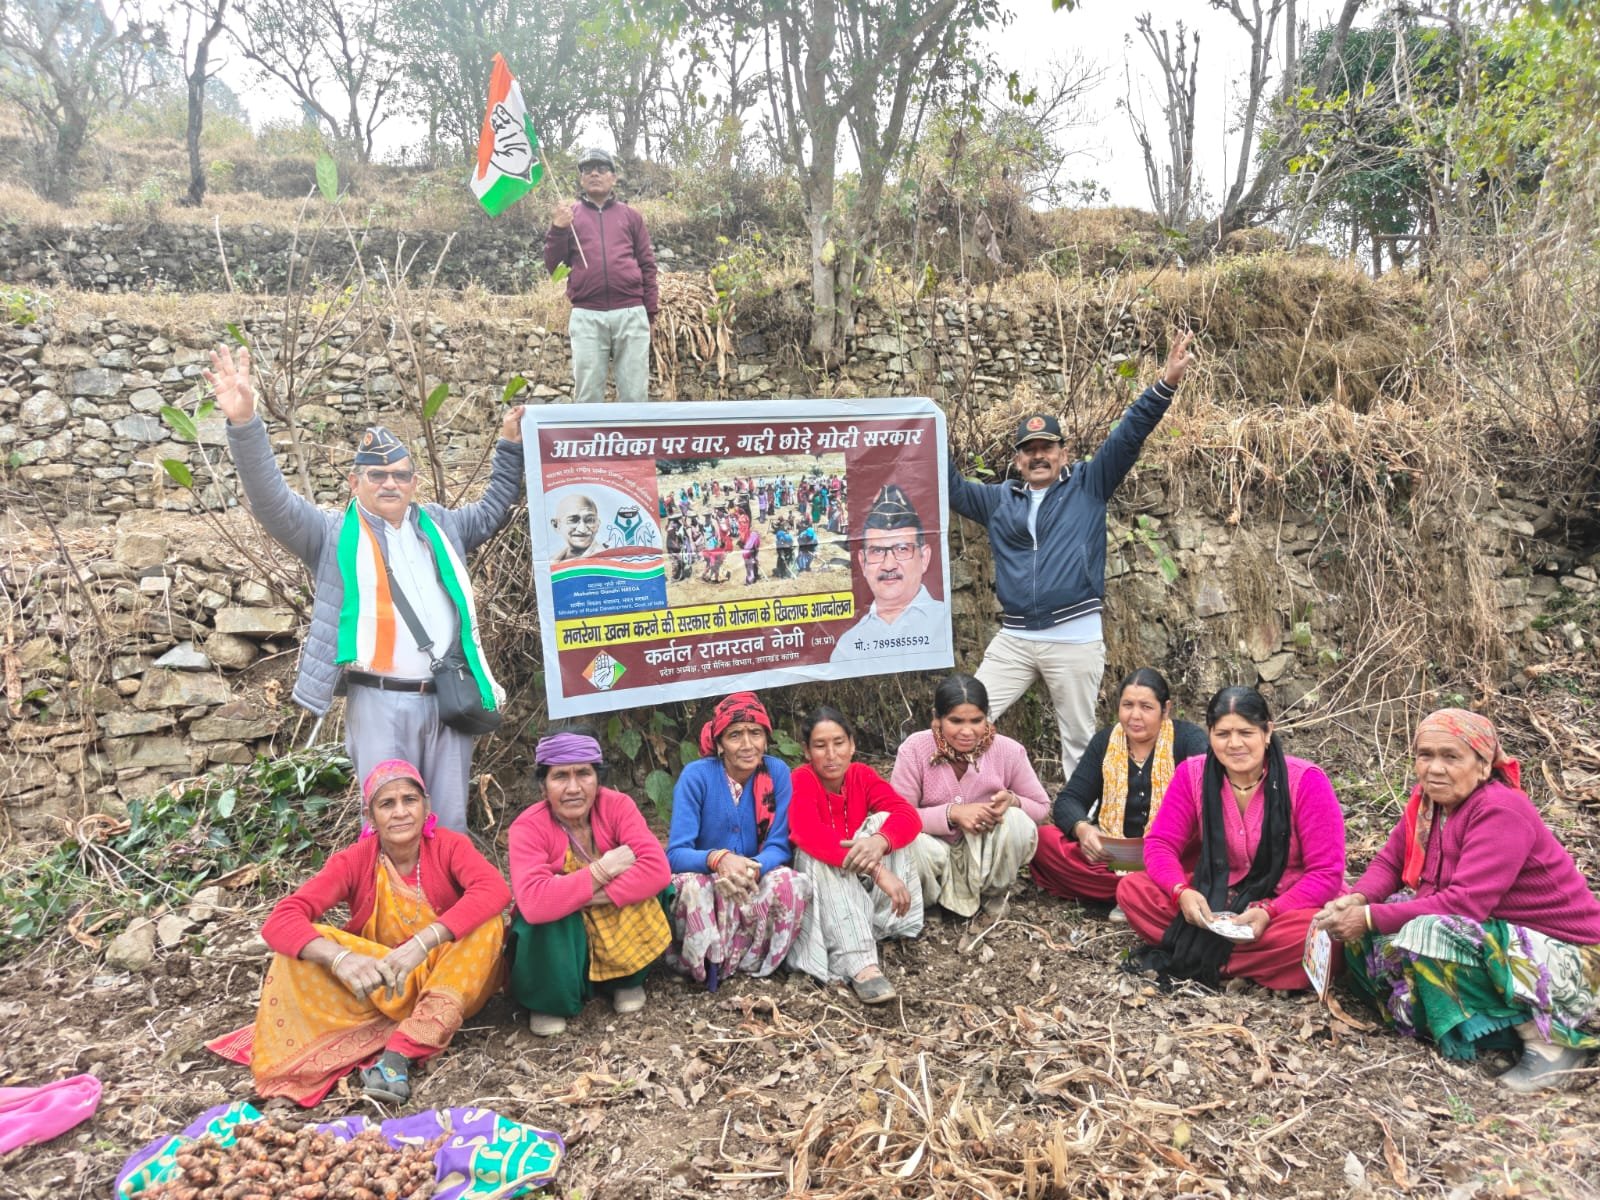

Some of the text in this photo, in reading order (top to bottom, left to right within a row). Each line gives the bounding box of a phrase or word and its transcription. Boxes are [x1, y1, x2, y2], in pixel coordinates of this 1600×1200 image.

[550, 426, 924, 458] आजीविका पर वार, गद्दी छोड़े मोदी सरकार
[562, 595, 852, 645] मनरेगा खत्म करने की सरकार की योजना के खिलाफ आन्दोलन
[644, 639, 692, 666] कर्नल
[697, 636, 765, 659] रामरतन
[770, 626, 805, 649] नेगी
[872, 635, 930, 650] 7895855592
